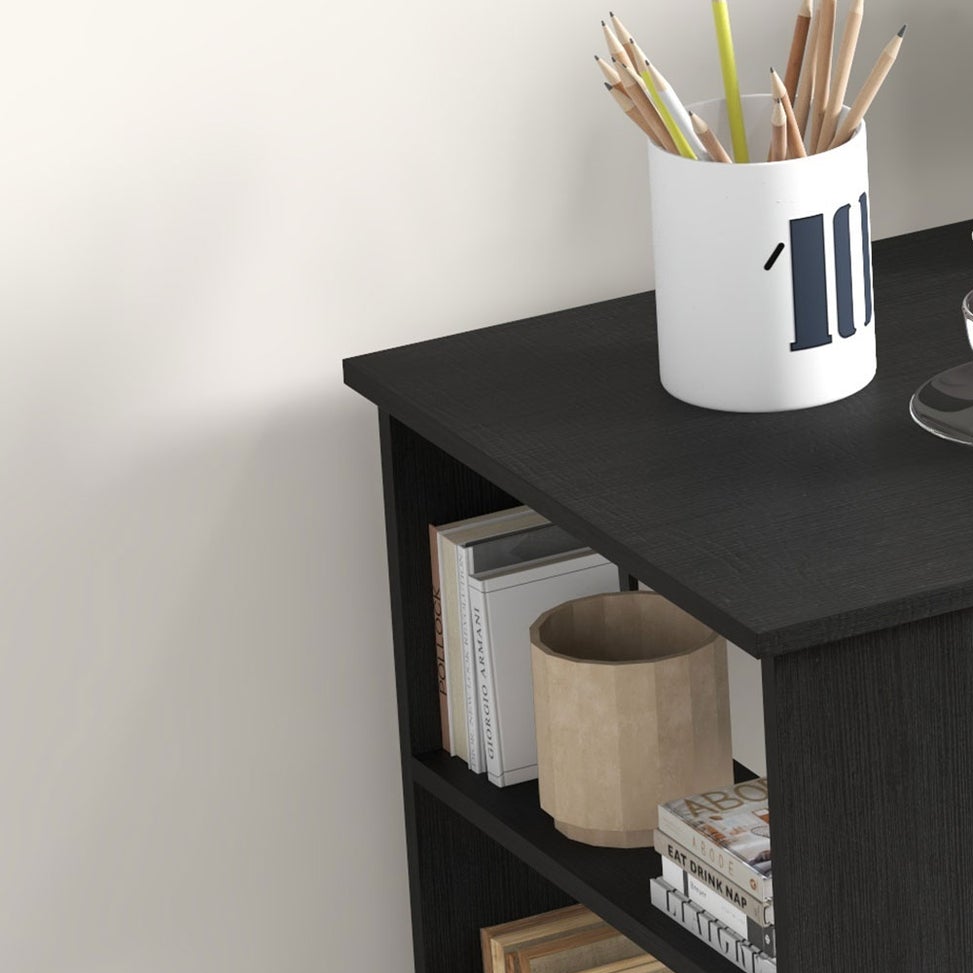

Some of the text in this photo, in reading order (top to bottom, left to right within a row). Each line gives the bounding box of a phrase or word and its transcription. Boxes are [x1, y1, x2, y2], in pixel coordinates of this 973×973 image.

[432, 587, 447, 696] POLLOCK
[474, 607, 494, 759] GIORGIO ARMANI
[684, 779, 768, 818] ABO
[667, 844, 748, 909] EAT DRINK NAP
